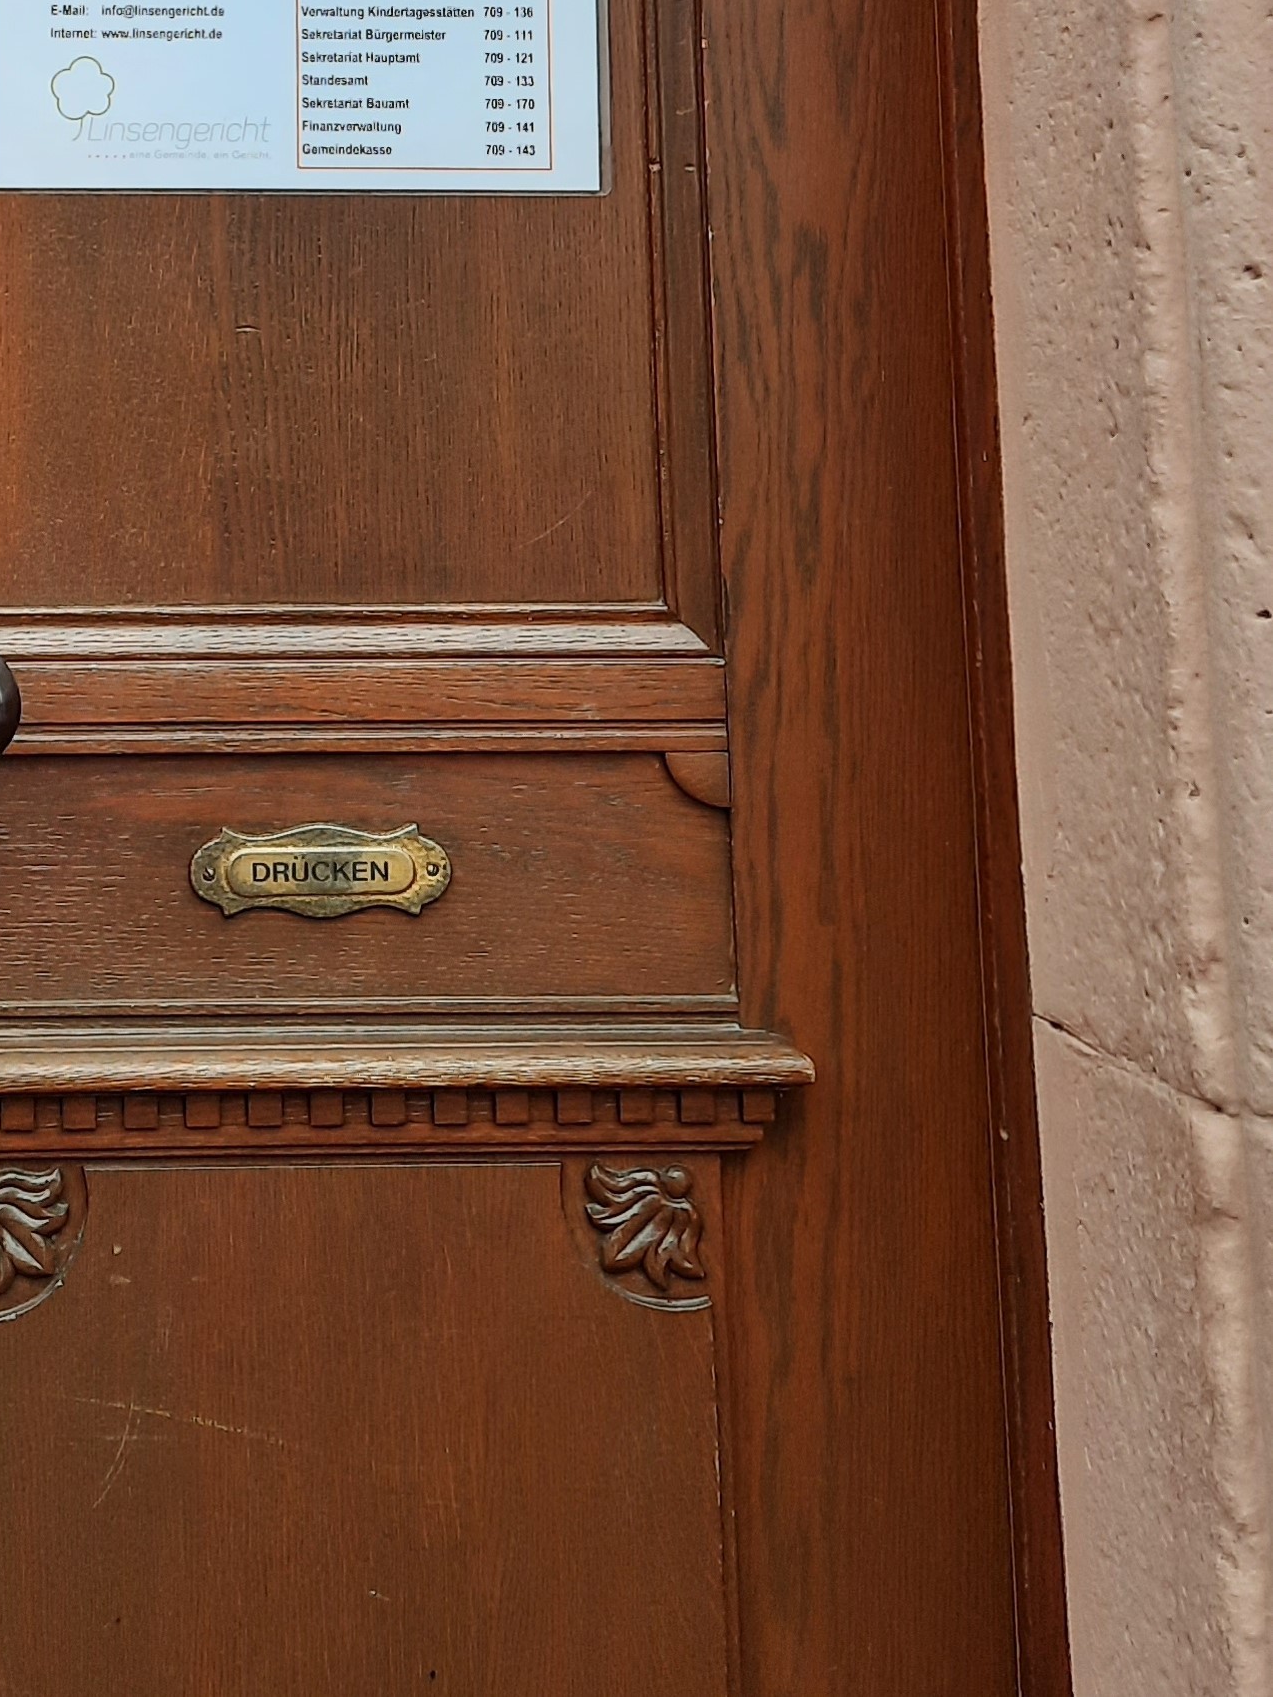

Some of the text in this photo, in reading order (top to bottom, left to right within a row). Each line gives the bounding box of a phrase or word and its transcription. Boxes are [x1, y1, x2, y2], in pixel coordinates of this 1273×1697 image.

[101, 4, 224, 19] info@linsengericht.de
[301, 6, 533, 20] Verwaltung Kindertagesstätten 709 136
[101, 28, 222, 42] www.linsengericht.de
[302, 28, 533, 43] Sekretariat Bürgermeister 709 111
[301, 51, 533, 66] Sekretariat Hauptamt 709 121
[302, 74, 535, 87] Standesamt 709 133
[302, 97, 535, 110] Sekretariat Bauamt 709 170
[302, 120, 534, 135] Finanzverwaltung 709 141
[302, 143, 536, 156] Gemeindekasse 709 143
[251, 855, 389, 883] DRÜCKEN
